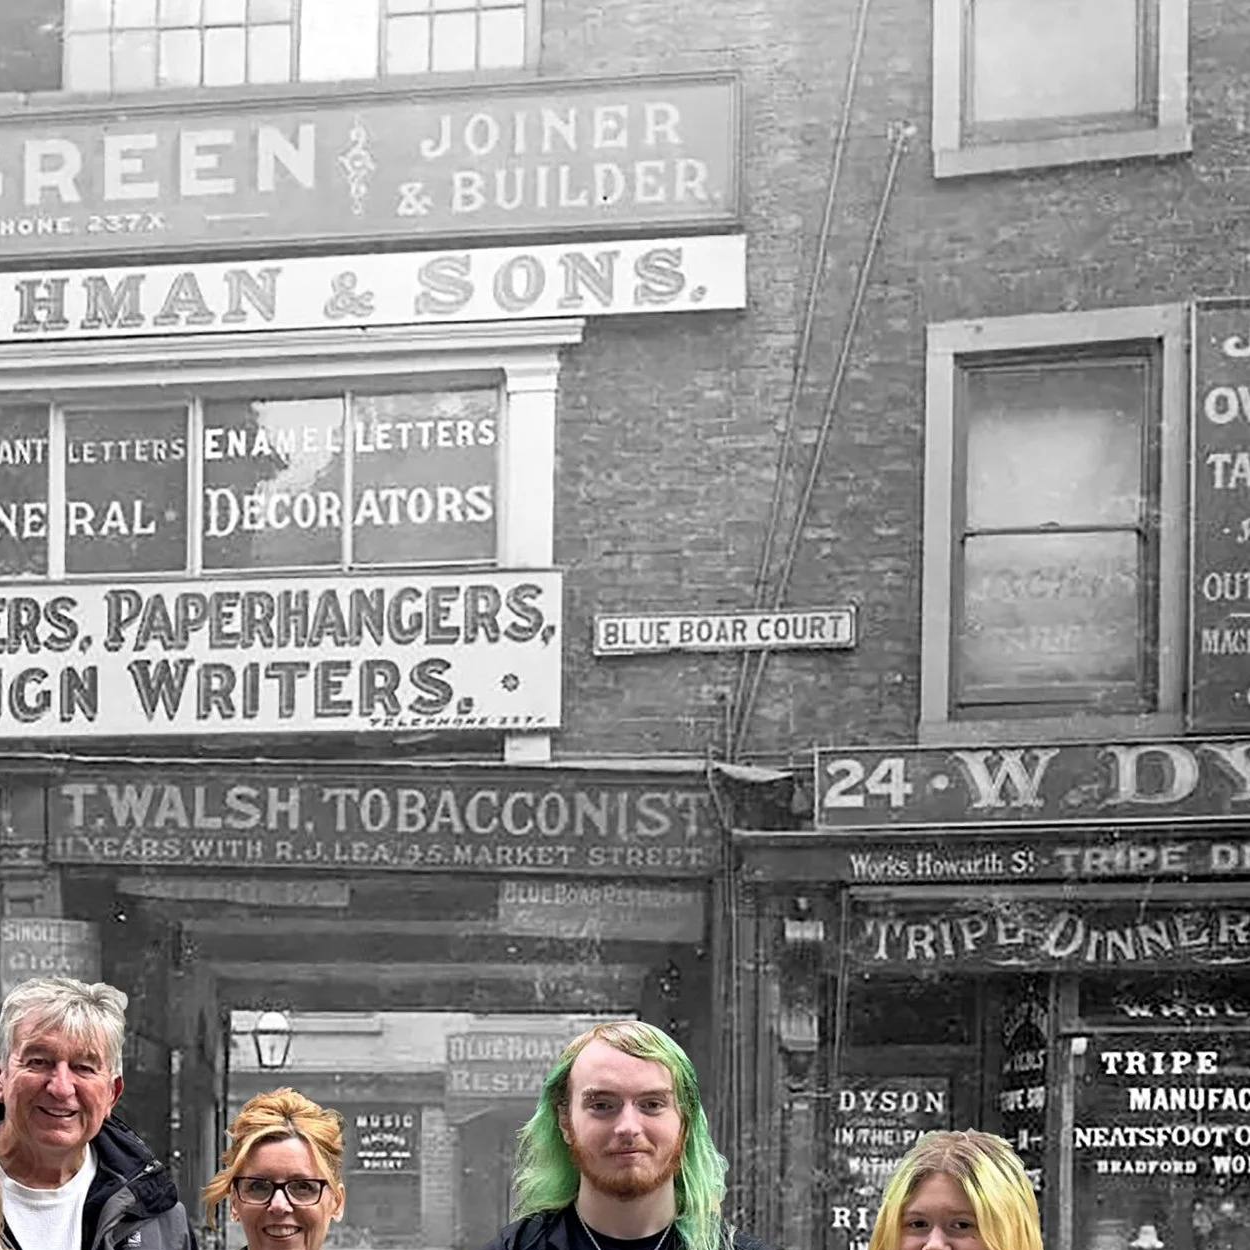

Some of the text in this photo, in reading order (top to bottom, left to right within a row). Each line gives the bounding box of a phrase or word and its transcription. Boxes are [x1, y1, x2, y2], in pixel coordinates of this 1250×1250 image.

[420, 102, 682, 160] JOINER
[396, 181, 435, 217] &
[323, 271, 375, 320] &
[414, 246, 709, 317] SONS.
[68, 438, 186, 464] LETTERS
[204, 425, 342, 460] ENAMEL
[355, 418, 497, 454] LETTERS
[205, 485, 494, 537] DECORATORS
[102, 581, 556, 654] PAPERHANGERS,
[603, 614, 845, 645] BLUE BOAR COURT
[126, 657, 475, 723] WRITERS.
[824, 757, 913, 808] 24
[191, 838, 263, 858] WITH
[452, 844, 576, 866] MARKET
[915, 850, 1004, 876] Howarth
[1053, 844, 1188, 874] TRIPE
[863, 913, 1026, 961] TRIPE
[1100, 1051, 1219, 1076] TRIPE
[838, 1091, 945, 1113] DYSON
[1073, 1125, 1230, 1148] NEATSFOOT
